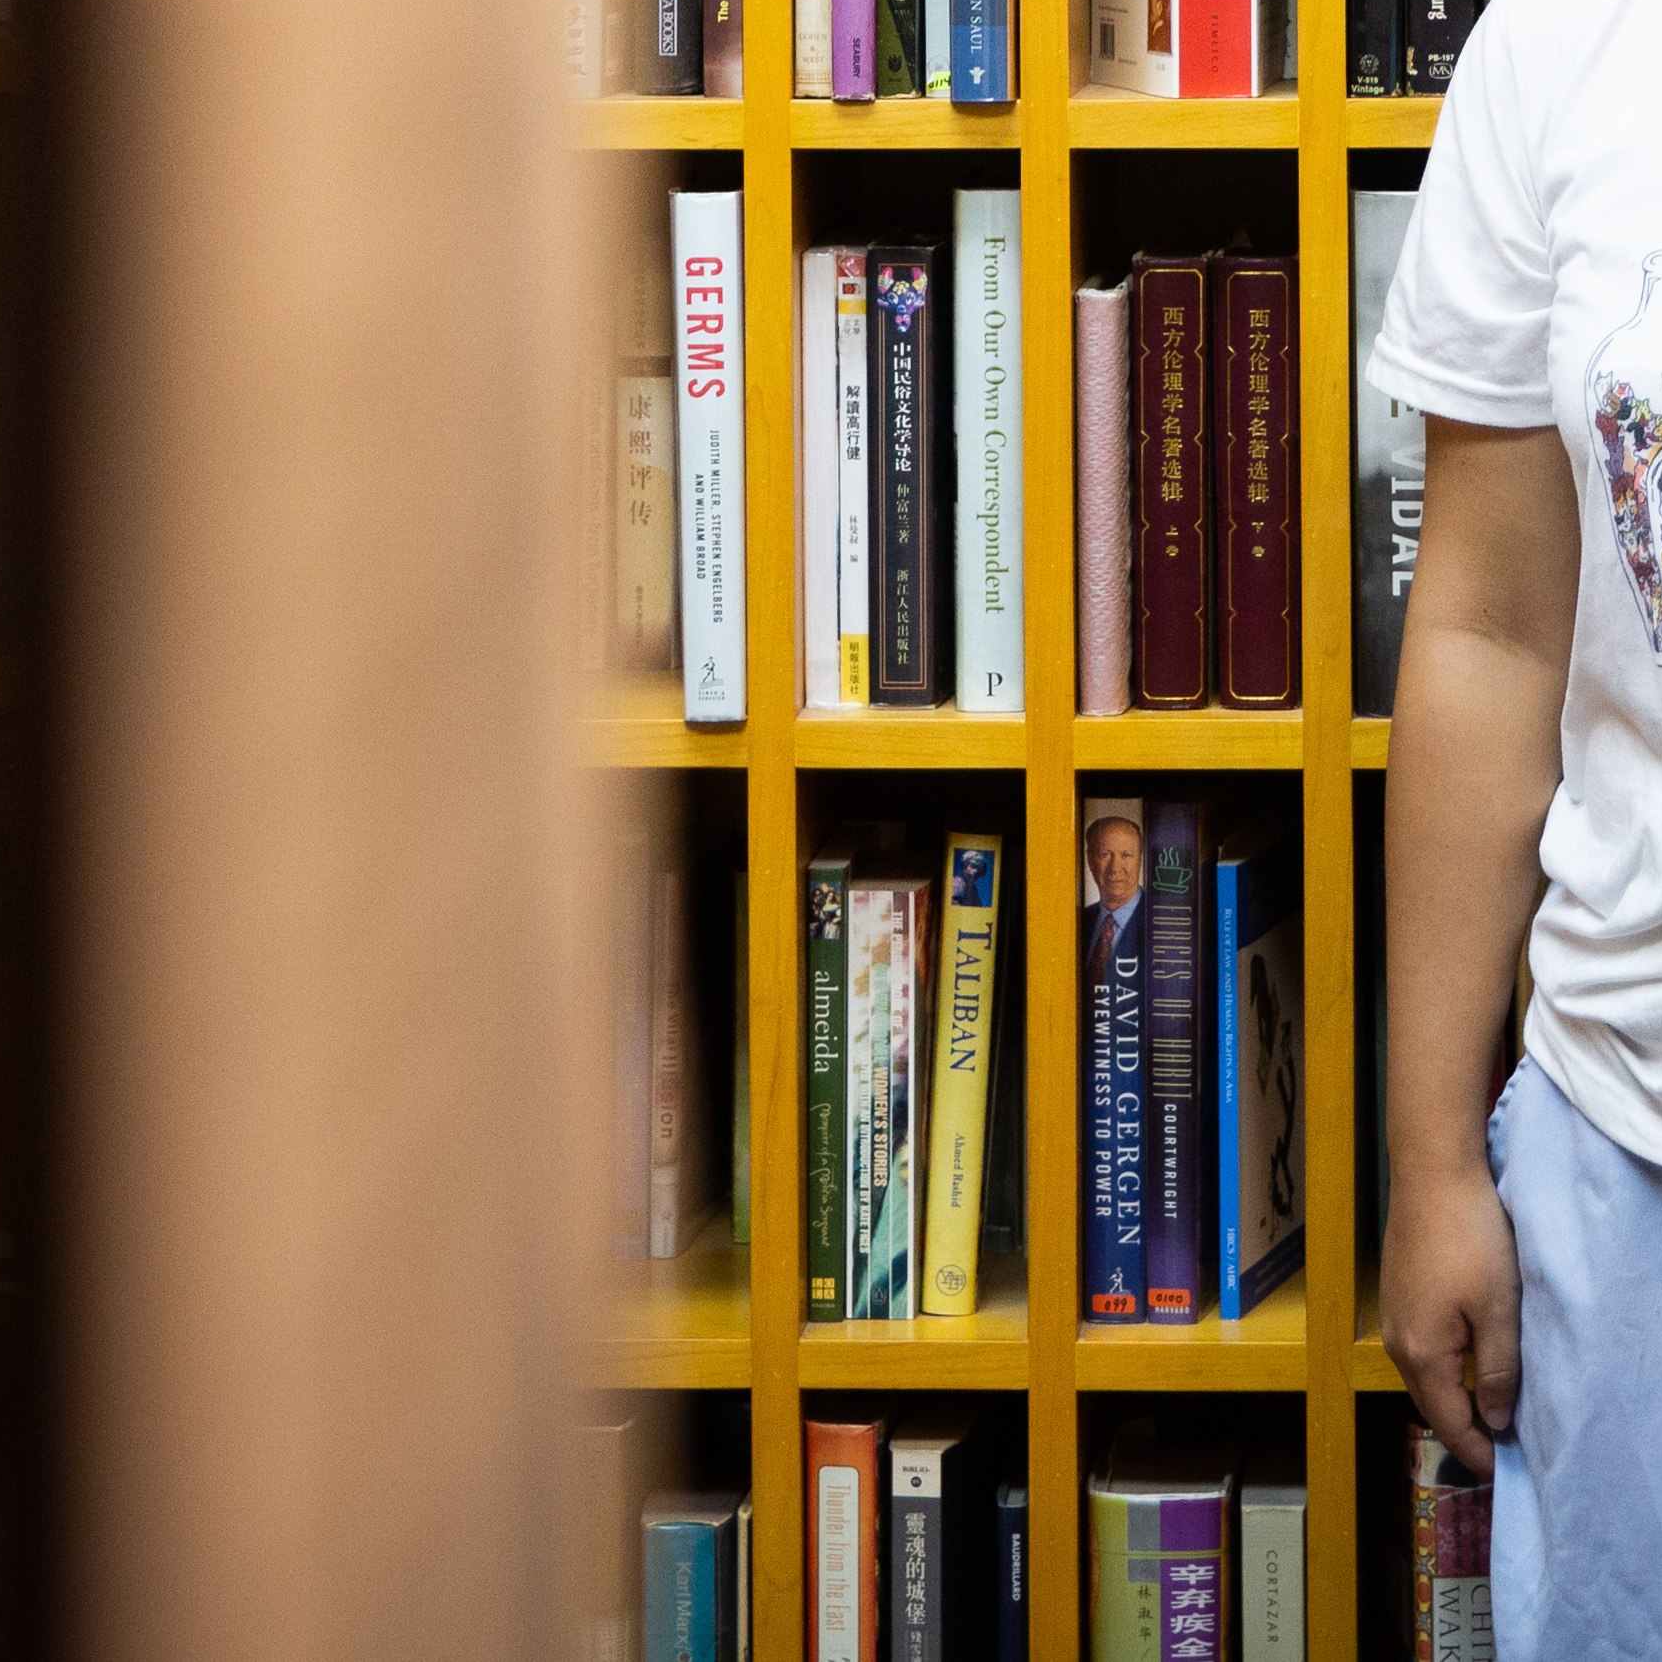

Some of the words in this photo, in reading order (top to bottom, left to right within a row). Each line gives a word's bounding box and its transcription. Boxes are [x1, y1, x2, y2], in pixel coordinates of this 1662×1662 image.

[983, 234, 1008, 301] From
[685, 257, 726, 399] GERMS
[984, 309, 1007, 359] Our
[984, 365, 1007, 421] Own
[1160, 306, 1185, 503] 西方伦理学名著选辑
[1247, 308, 1271, 504] 西方伦理学名著选辑
[975, 429, 1010, 614] Correspondent
[814, 970, 831, 1074] almeida
[950, 922, 994, 1072] TALIBAN
[1094, 984, 1112, 1107] EYEWITNESS
[1115, 956, 1140, 1073] DAVID
[1094, 1116, 1112, 1140] TO
[1095, 1150, 1113, 1217] POWER
[1115, 1091, 1141, 1245] GERGEN
[1163, 1103, 1178, 1219] COURTWRIGHT
[1011, 1532, 1022, 1602] BAUDRILLARD
